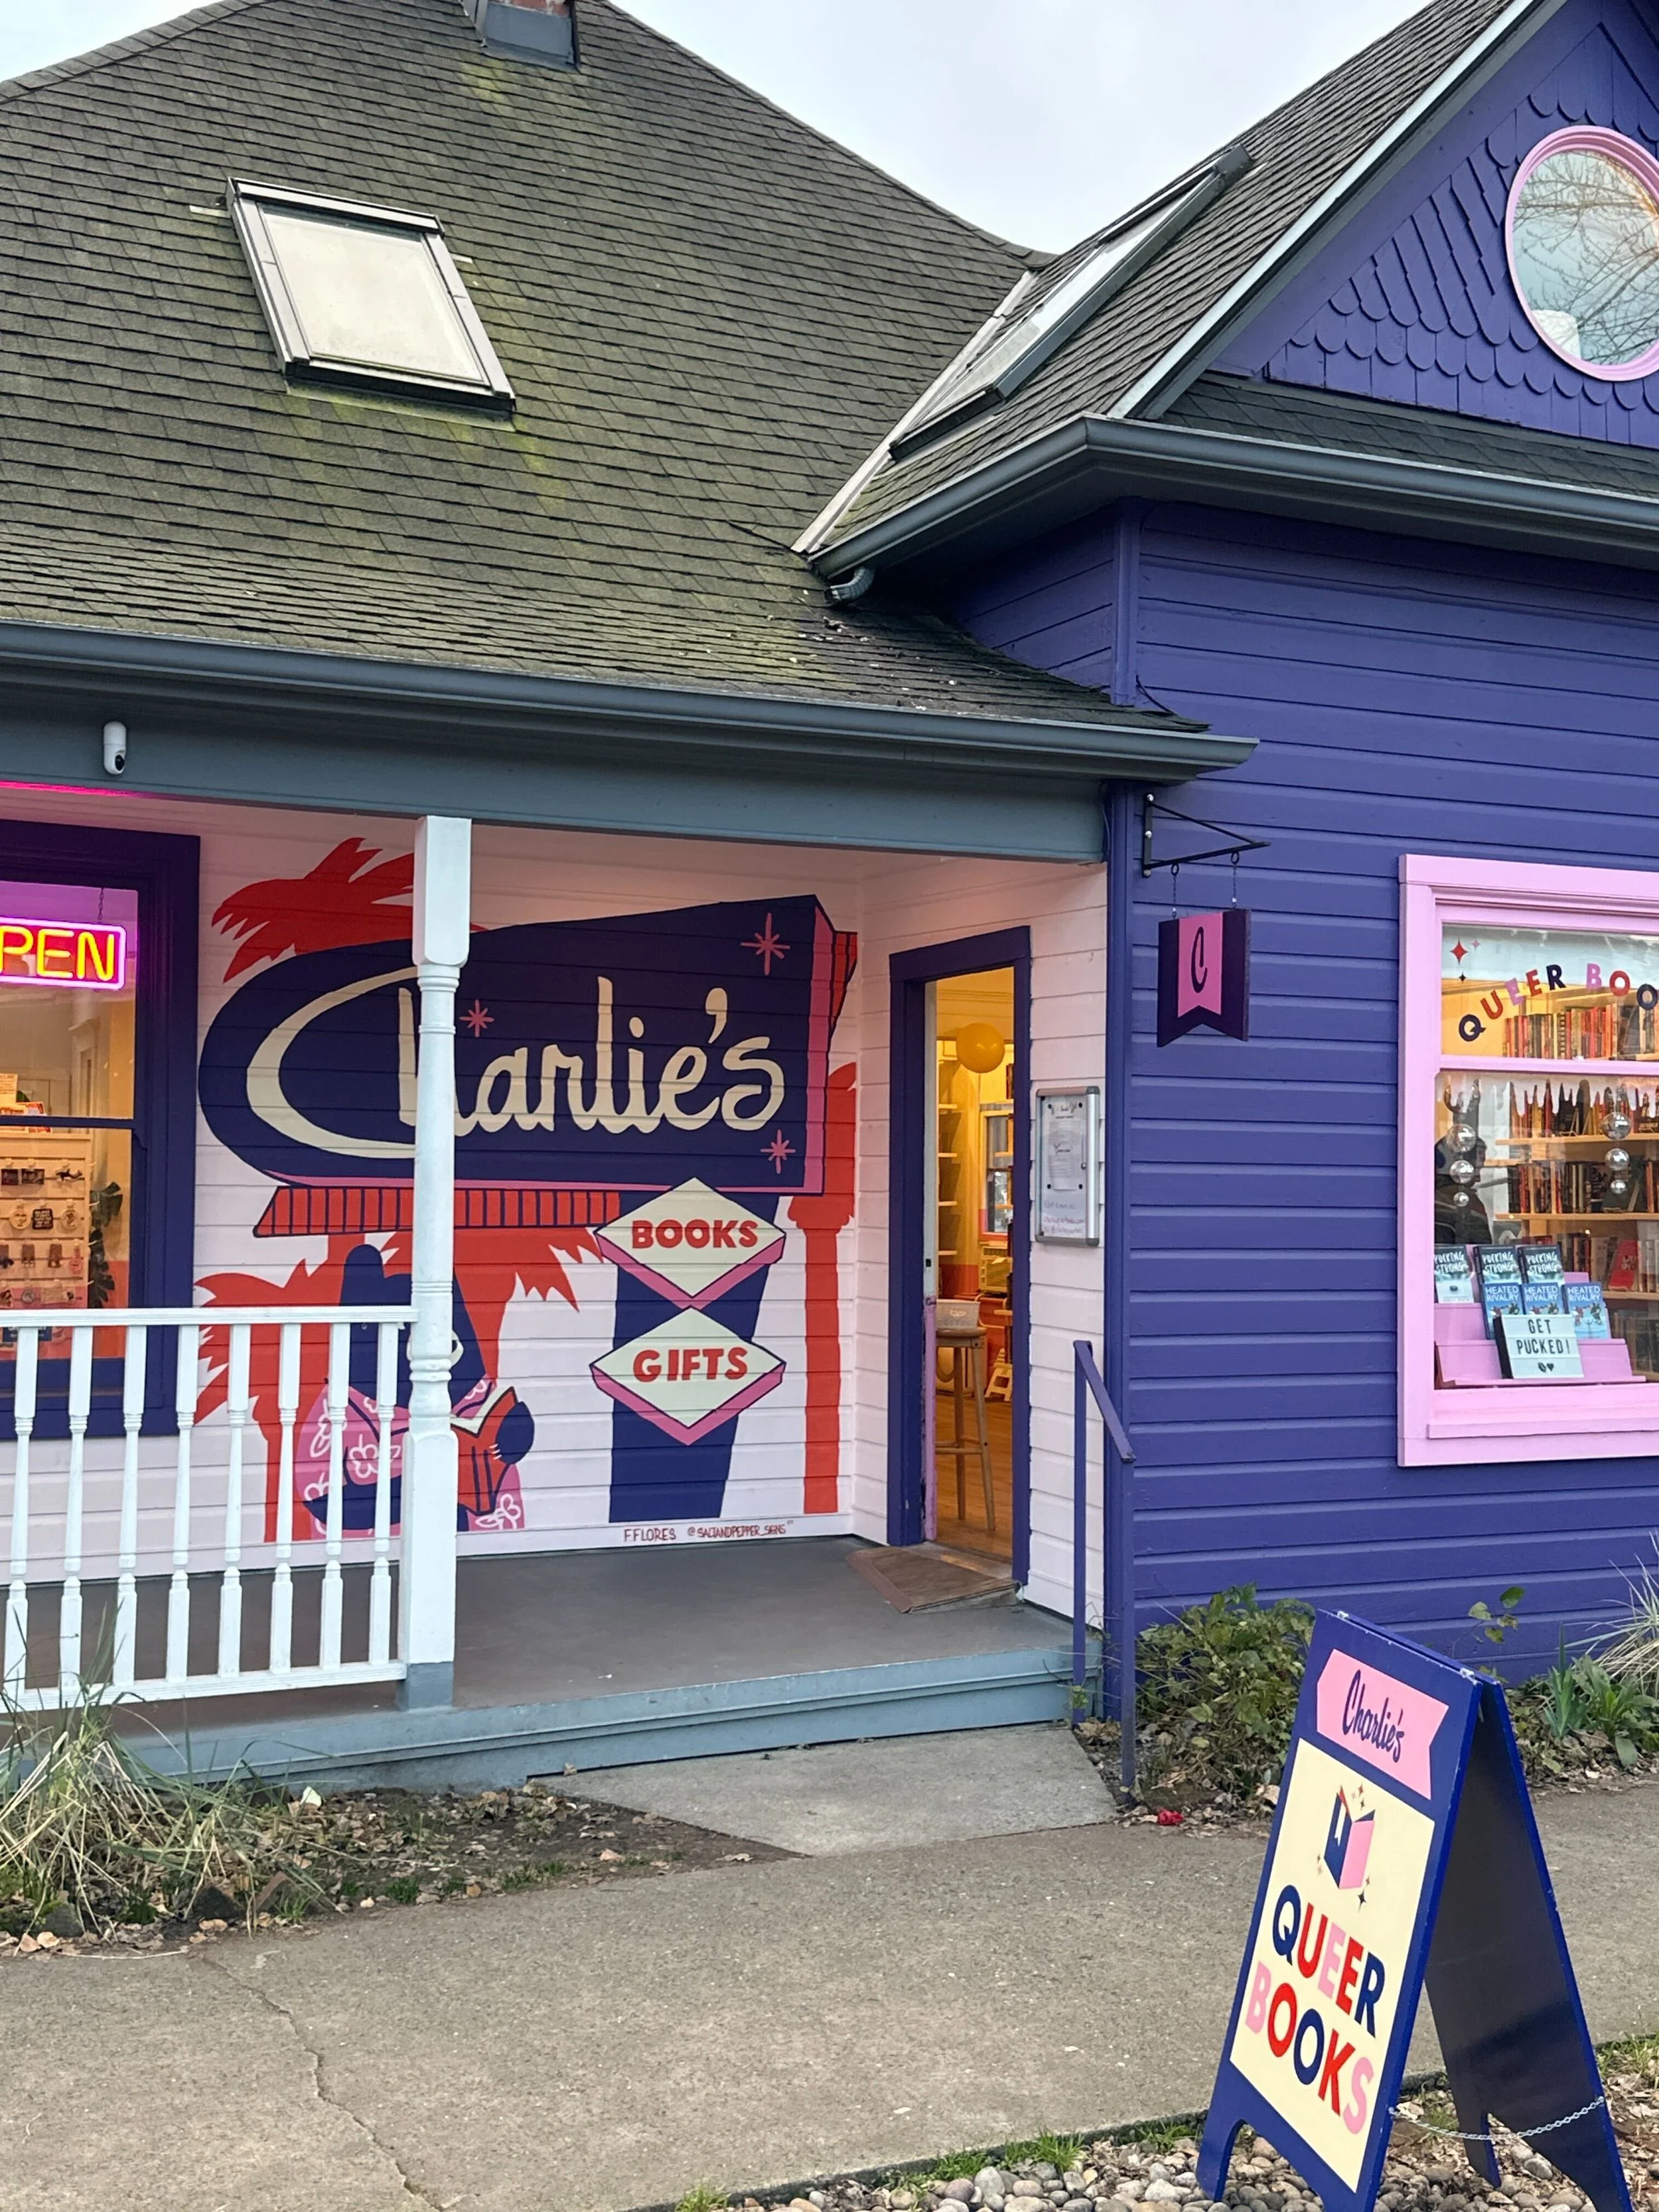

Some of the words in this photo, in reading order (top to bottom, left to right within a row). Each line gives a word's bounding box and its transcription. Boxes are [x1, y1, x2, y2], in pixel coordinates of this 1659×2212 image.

[0, 925, 115, 981] PEN
[1191, 926, 1208, 994] C
[1459, 964, 1567, 1042] QUEER
[246, 966, 786, 1159] Charlie's
[632, 1219, 758, 1249] BOOKS
[1482, 1251, 1514, 1264] PUCKING
[1484, 1262, 1514, 1274] STRONG
[1526, 1251, 1558, 1264] PUCKING
[1528, 1262, 1558, 1274] STRONG
[1484, 1286, 1520, 1295] HEATED
[1524, 1286, 1558, 1295] HEATED
[1567, 1286, 1601, 1295] HEATED
[1528, 1318, 1552, 1335] GET
[1516, 1338, 1571, 1355] PUCKED!
[632, 1346, 749, 1383] GIFTS
[1342, 1669, 1405, 1763] Charlie's
[1272, 1884, 1386, 2039] QUEER
[1245, 1960, 1374, 2135] BOOKS
